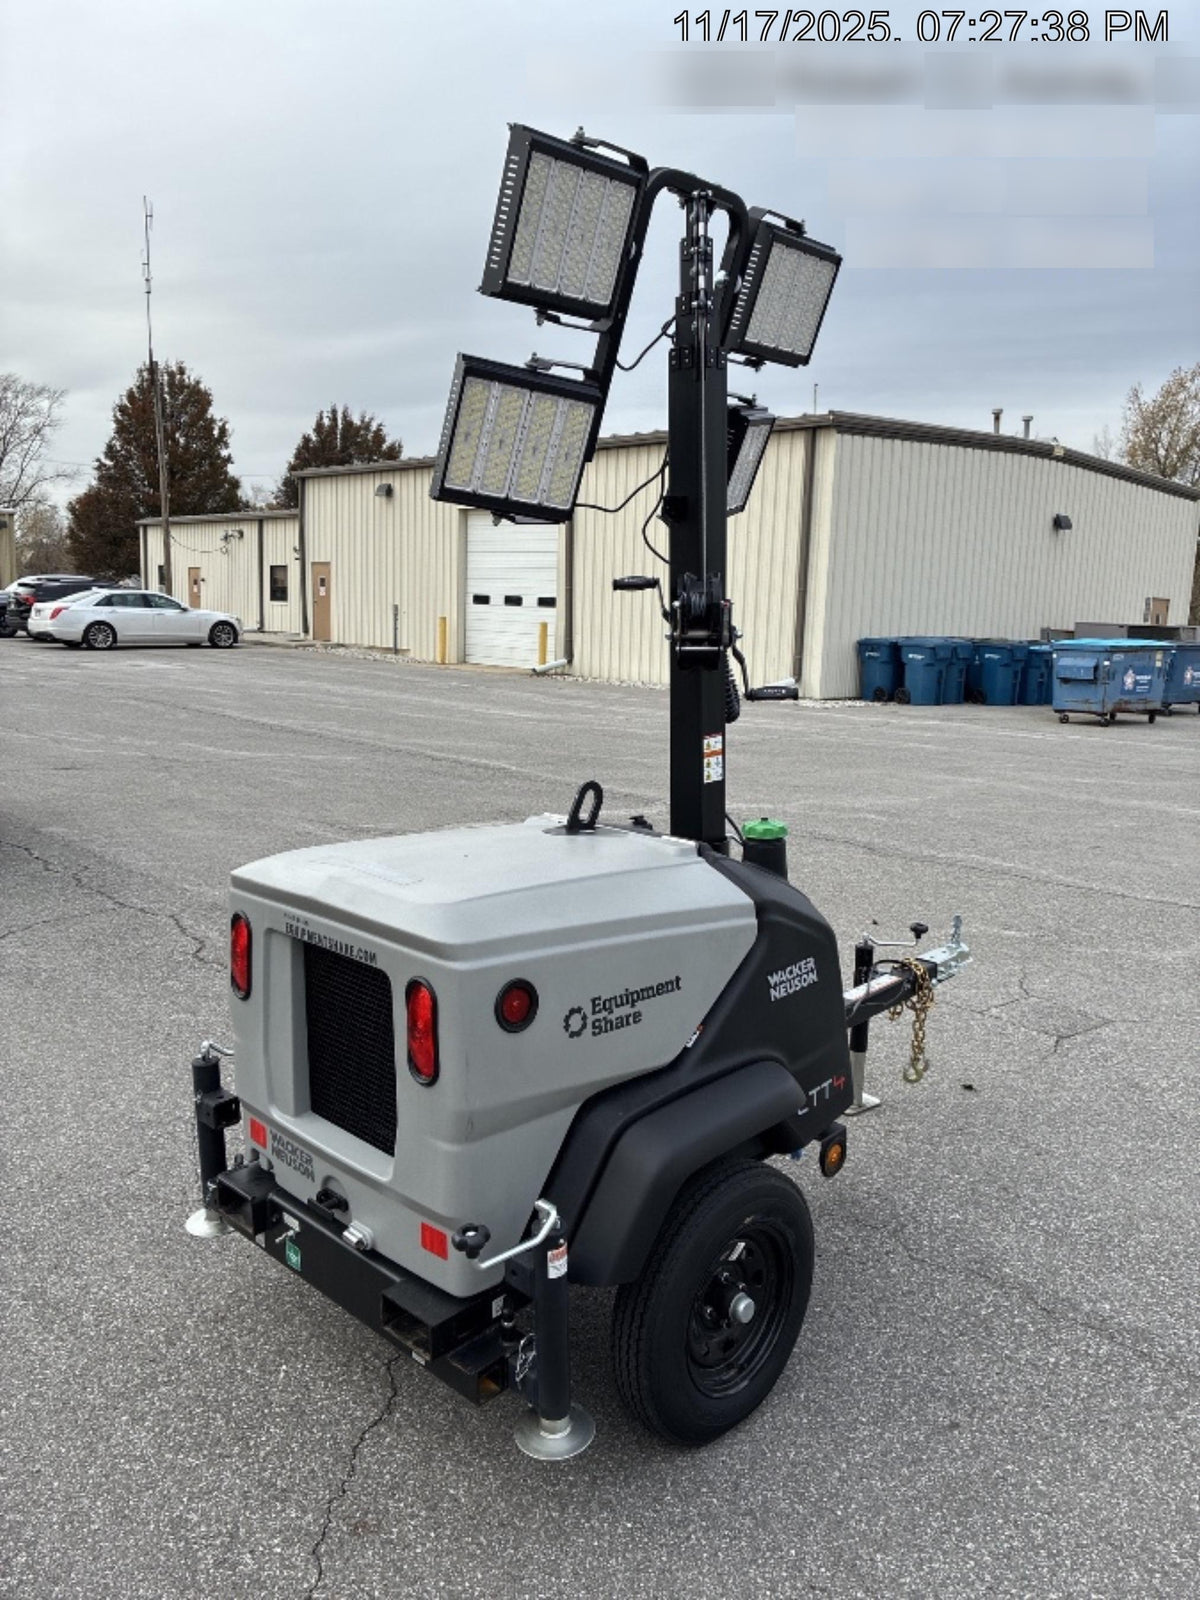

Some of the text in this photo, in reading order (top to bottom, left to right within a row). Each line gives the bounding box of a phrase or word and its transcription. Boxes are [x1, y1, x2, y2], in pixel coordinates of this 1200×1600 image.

[767, 957, 816, 988] WACKER
[769, 969, 819, 1002] NEUSON
[590, 975, 682, 1016] Equipment
[591, 1010, 643, 1037] Share
